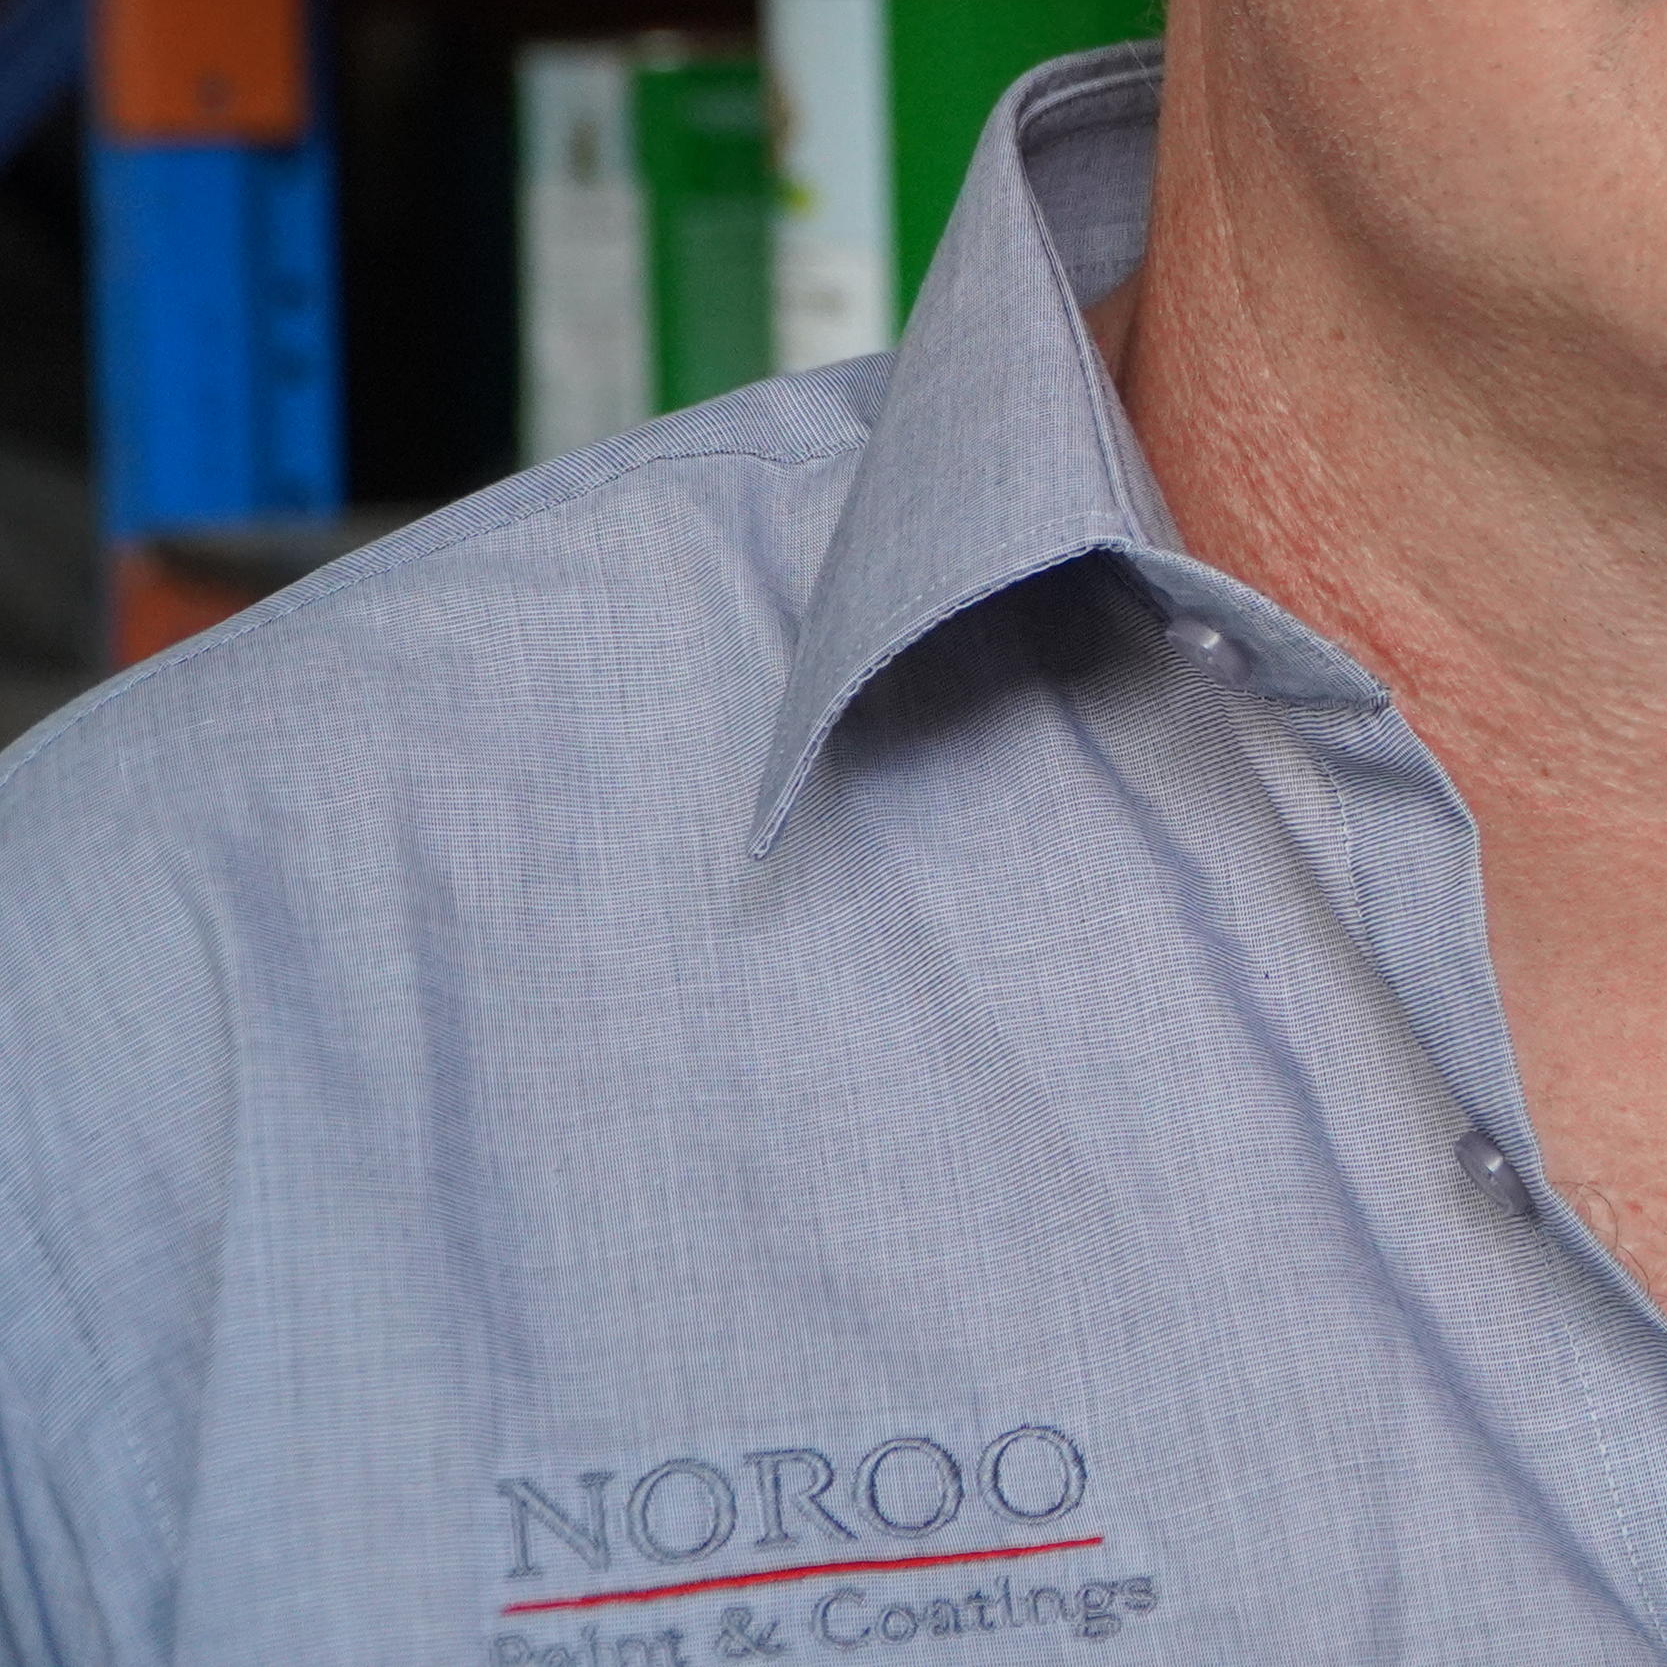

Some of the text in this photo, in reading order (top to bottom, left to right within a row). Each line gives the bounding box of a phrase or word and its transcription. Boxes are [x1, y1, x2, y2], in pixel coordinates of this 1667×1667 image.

[497, 1423, 1088, 1581] NOROO
[715, 1605, 786, 1658] &
[809, 1572, 1160, 1651] Coatings
